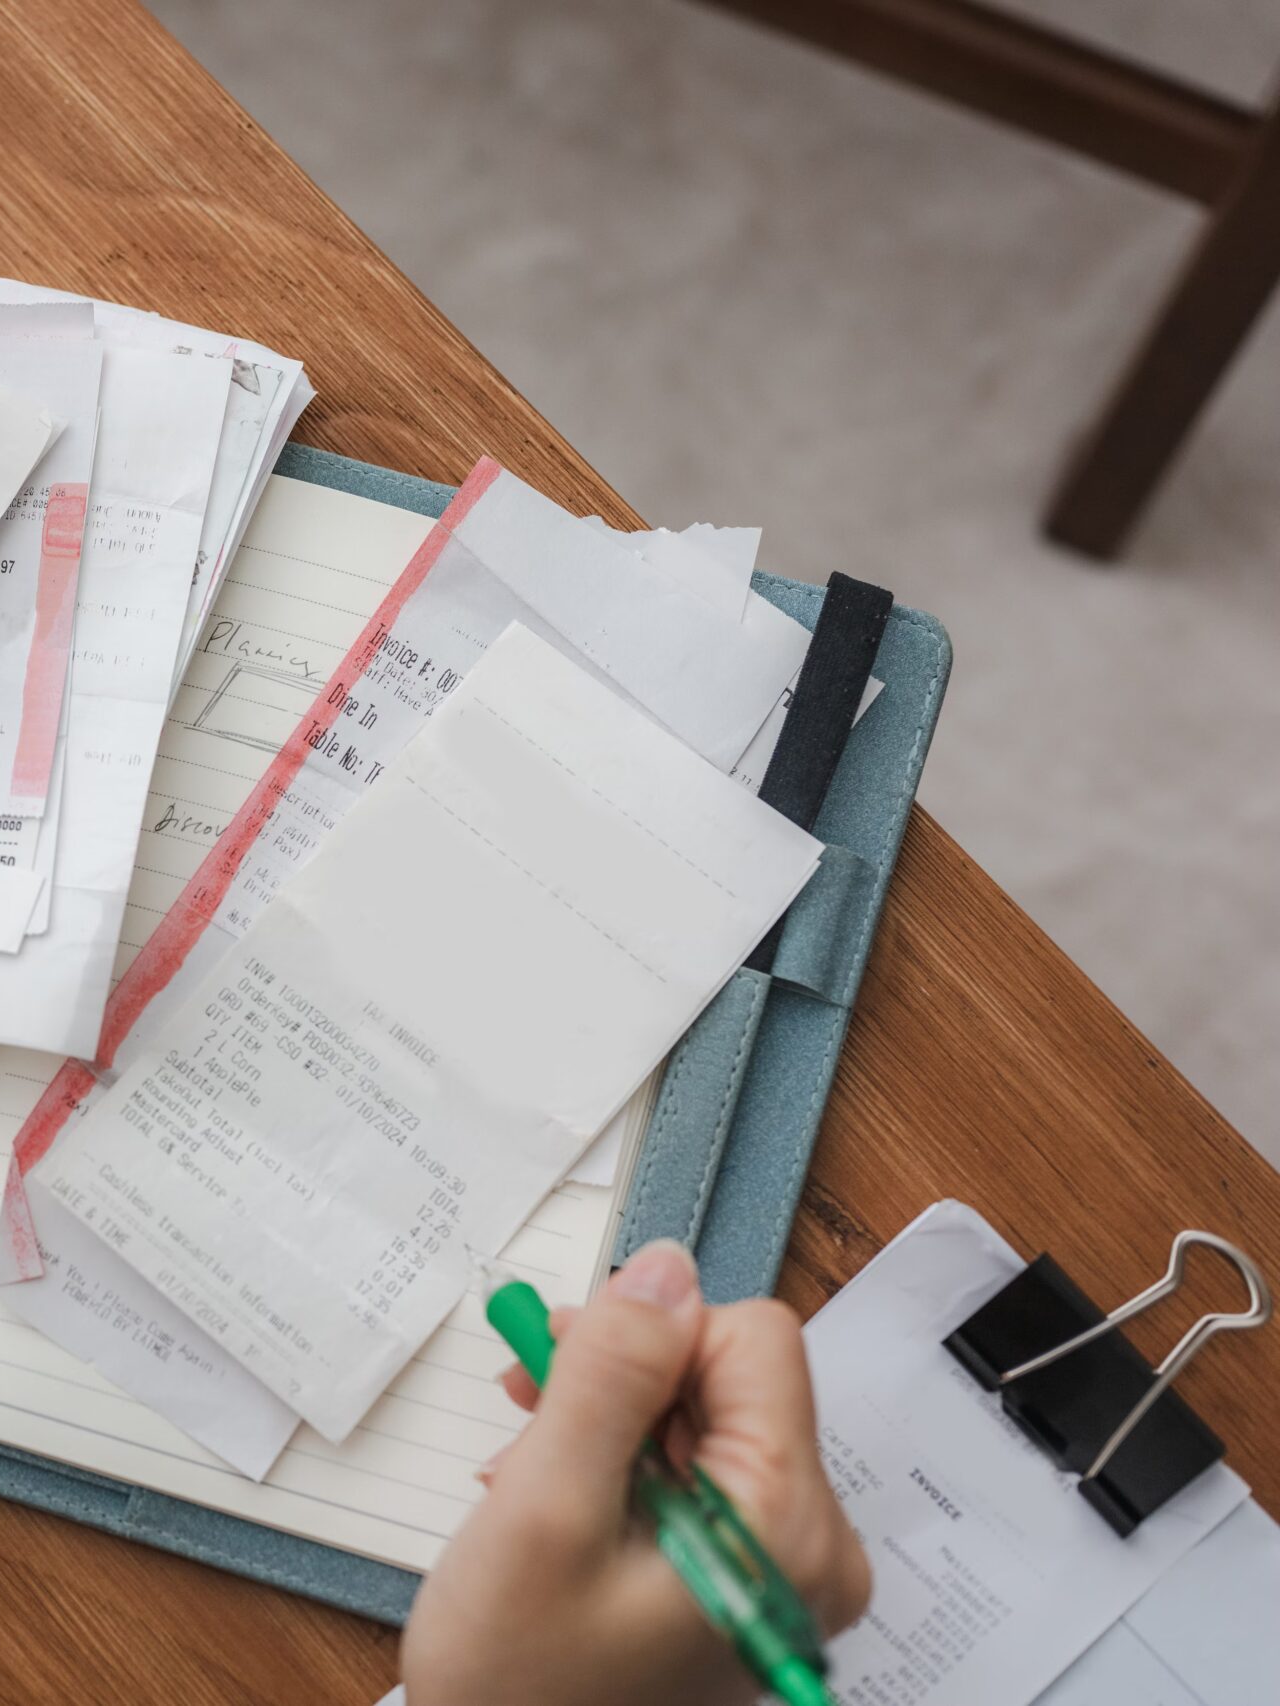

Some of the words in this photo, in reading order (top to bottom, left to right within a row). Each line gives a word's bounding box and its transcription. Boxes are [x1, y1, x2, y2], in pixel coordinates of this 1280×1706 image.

[368, 622, 419, 669] Invoice
[327, 682, 360, 718] Dine
[359, 703, 379, 731] In
[303, 719, 341, 760] Table
[338, 744, 364, 775] No:
[244, 957, 276, 985] INV#
[205, 1002, 232, 1026] QTY
[231, 1025, 263, 1055] ITEM
[237, 977, 301, 1033] OrderKey#
[204, 1028, 218, 1043] 2
[231, 1050, 262, 1081] Corn
[388, 1022, 440, 1069] INVOICE
[165, 1049, 224, 1101] Subtotal
[204, 1056, 262, 1108] ApplePie
[218, 987, 243, 1011] ORD
[245, 1011, 270, 1033] #69
[336, 1084, 408, 1147] 01/10/2024
[409, 1144, 467, 1196] 10:09:30
[129, 1089, 203, 1153] Mastercard
[141, 1076, 199, 1130] Rounding
[201, 1127, 244, 1167] Adjust
[154, 1065, 202, 1110] TakeOut
[207, 1107, 244, 1142] Total
[120, 1103, 155, 1139] TOTAL
[177, 1152, 228, 1198] Service
[100, 1217, 131, 1248] TIME
[409, 1225, 441, 1256] 4.10
[371, 1268, 404, 1299] 0.01
[378, 1249, 417, 1285] 17.34
[354, 1278, 393, 1315] 17.35
[909, 1466, 964, 1522] INVOICE
